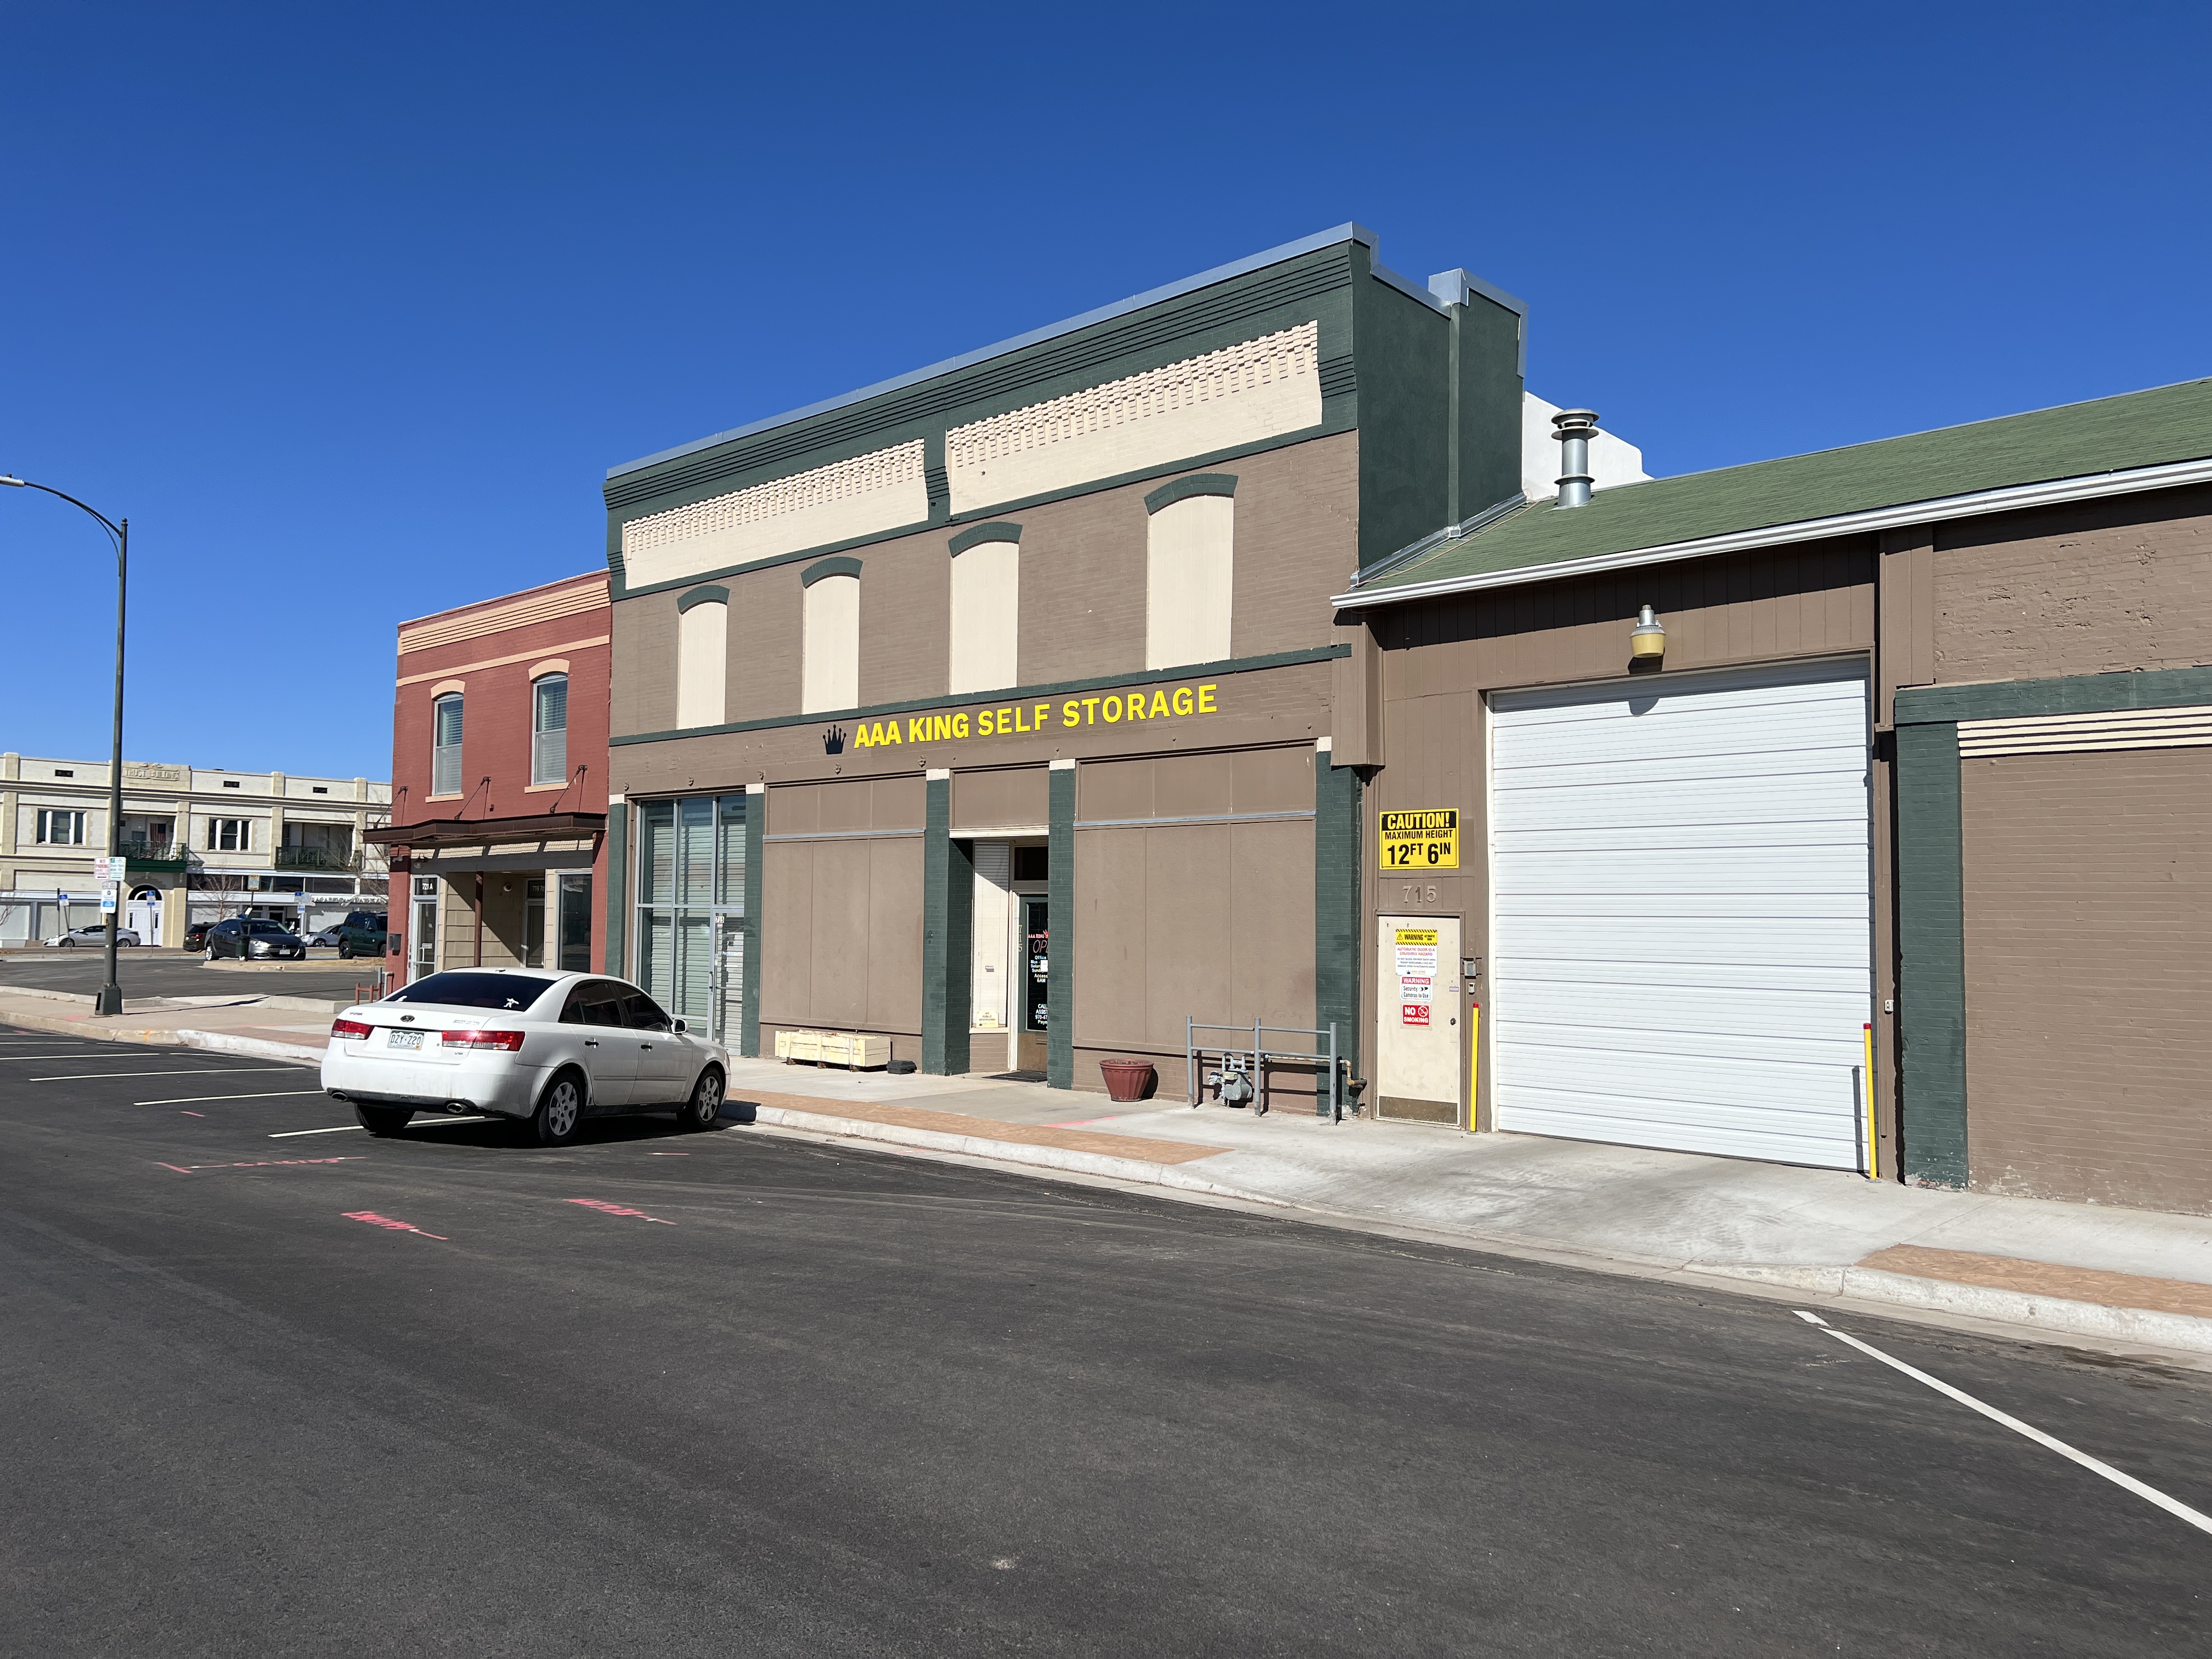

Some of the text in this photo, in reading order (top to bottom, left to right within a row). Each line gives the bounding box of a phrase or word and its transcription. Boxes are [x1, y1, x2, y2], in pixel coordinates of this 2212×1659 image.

[854, 684, 1217, 748] AAA KING SELF STORAGE
[1387, 812, 1449, 830] CAUTION!
[1385, 830, 1453, 839] MAXIMUM HEIGHT
[1402, 885, 1436, 903] 715
[1404, 1007, 1415, 1015] NO
